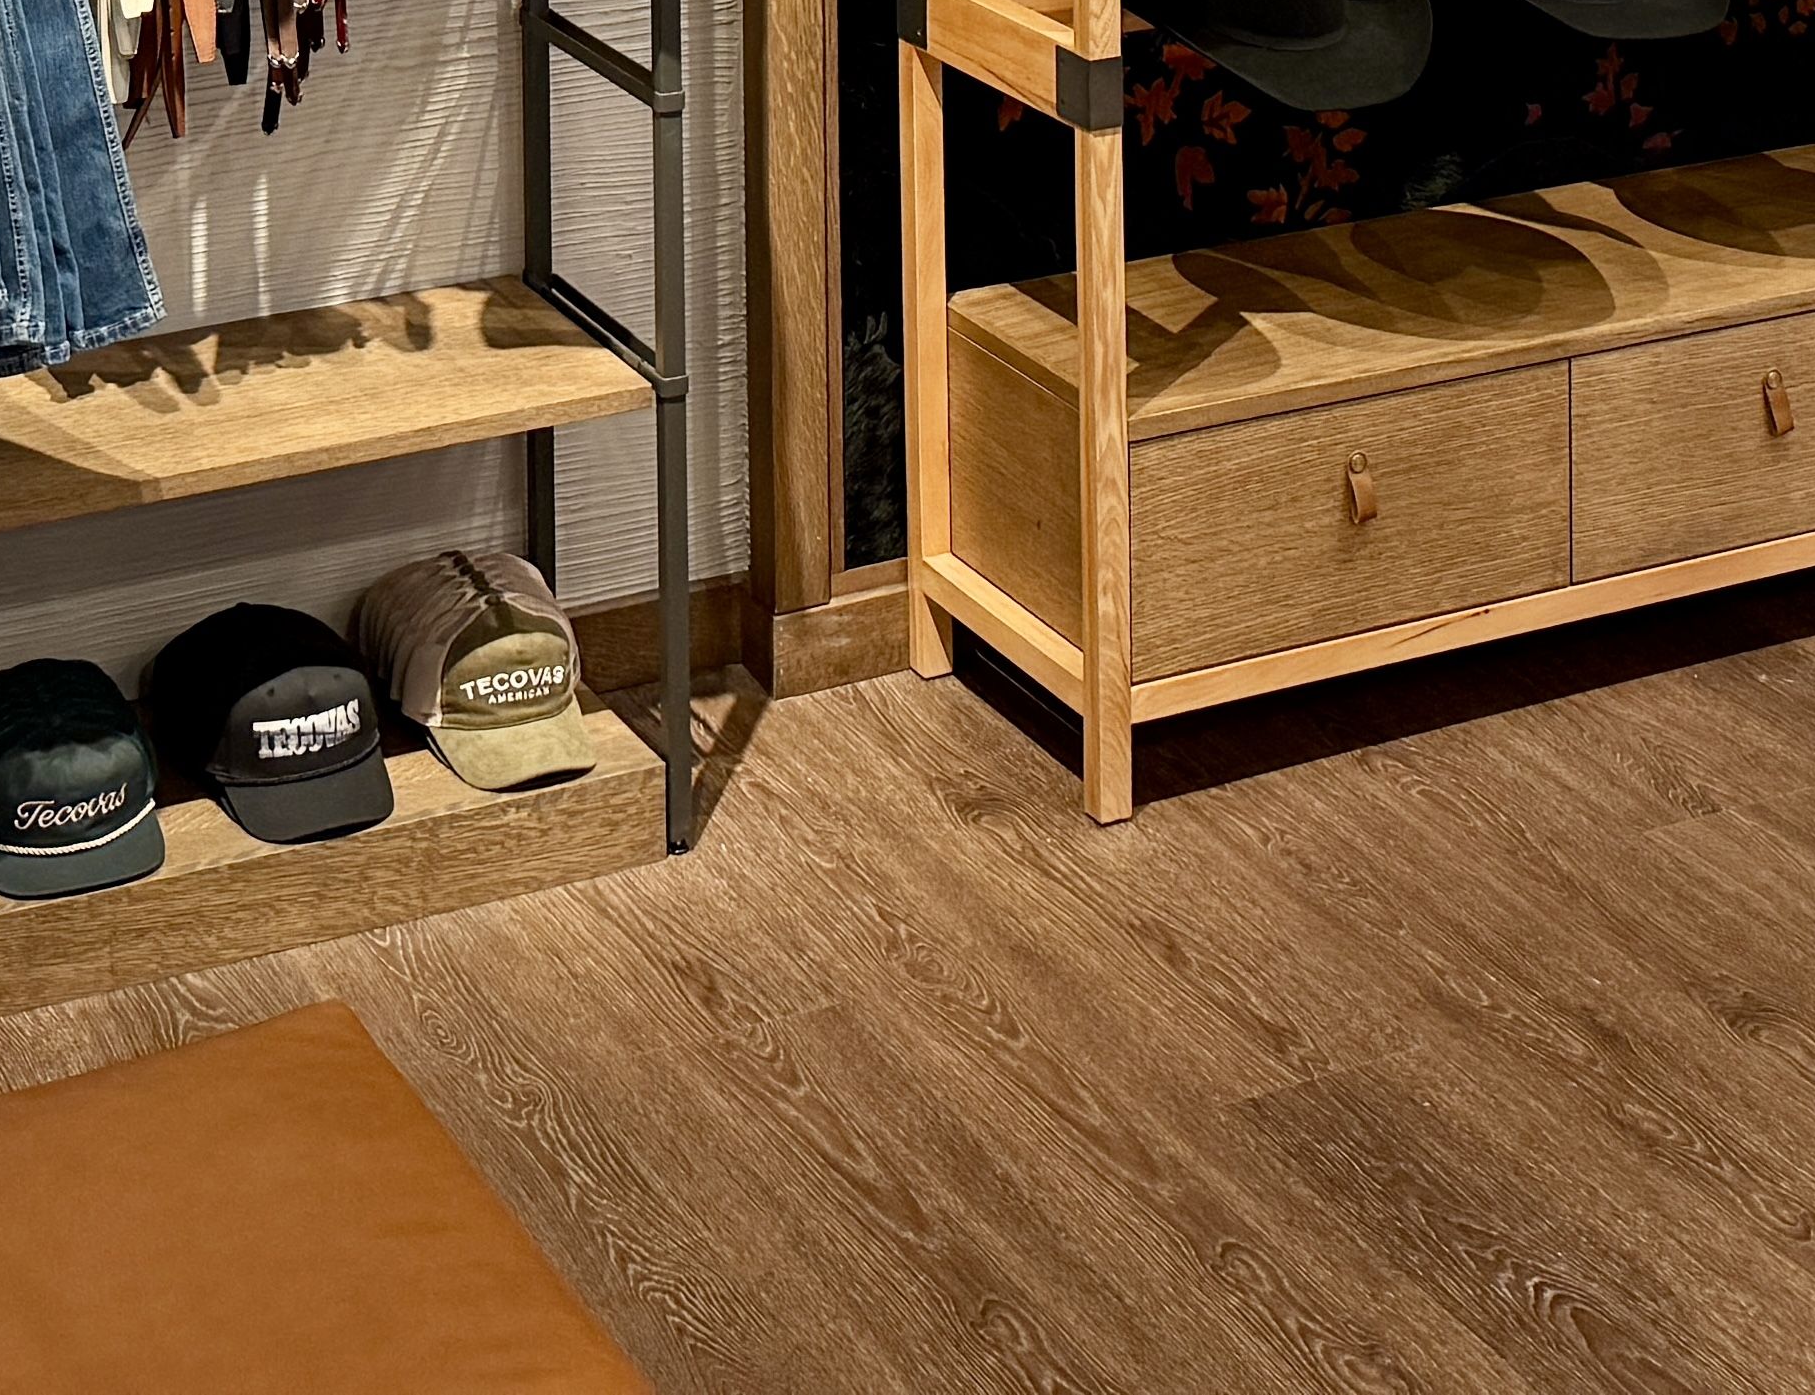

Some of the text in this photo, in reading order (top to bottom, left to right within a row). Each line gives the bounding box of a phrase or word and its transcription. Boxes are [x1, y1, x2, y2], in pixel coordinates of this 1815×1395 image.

[459, 665, 565, 700] TECOVAS
[488, 685, 550, 704] AMERICAN
[252, 698, 361, 759] TECOVAS
[13, 782, 128, 830] Tecovas
